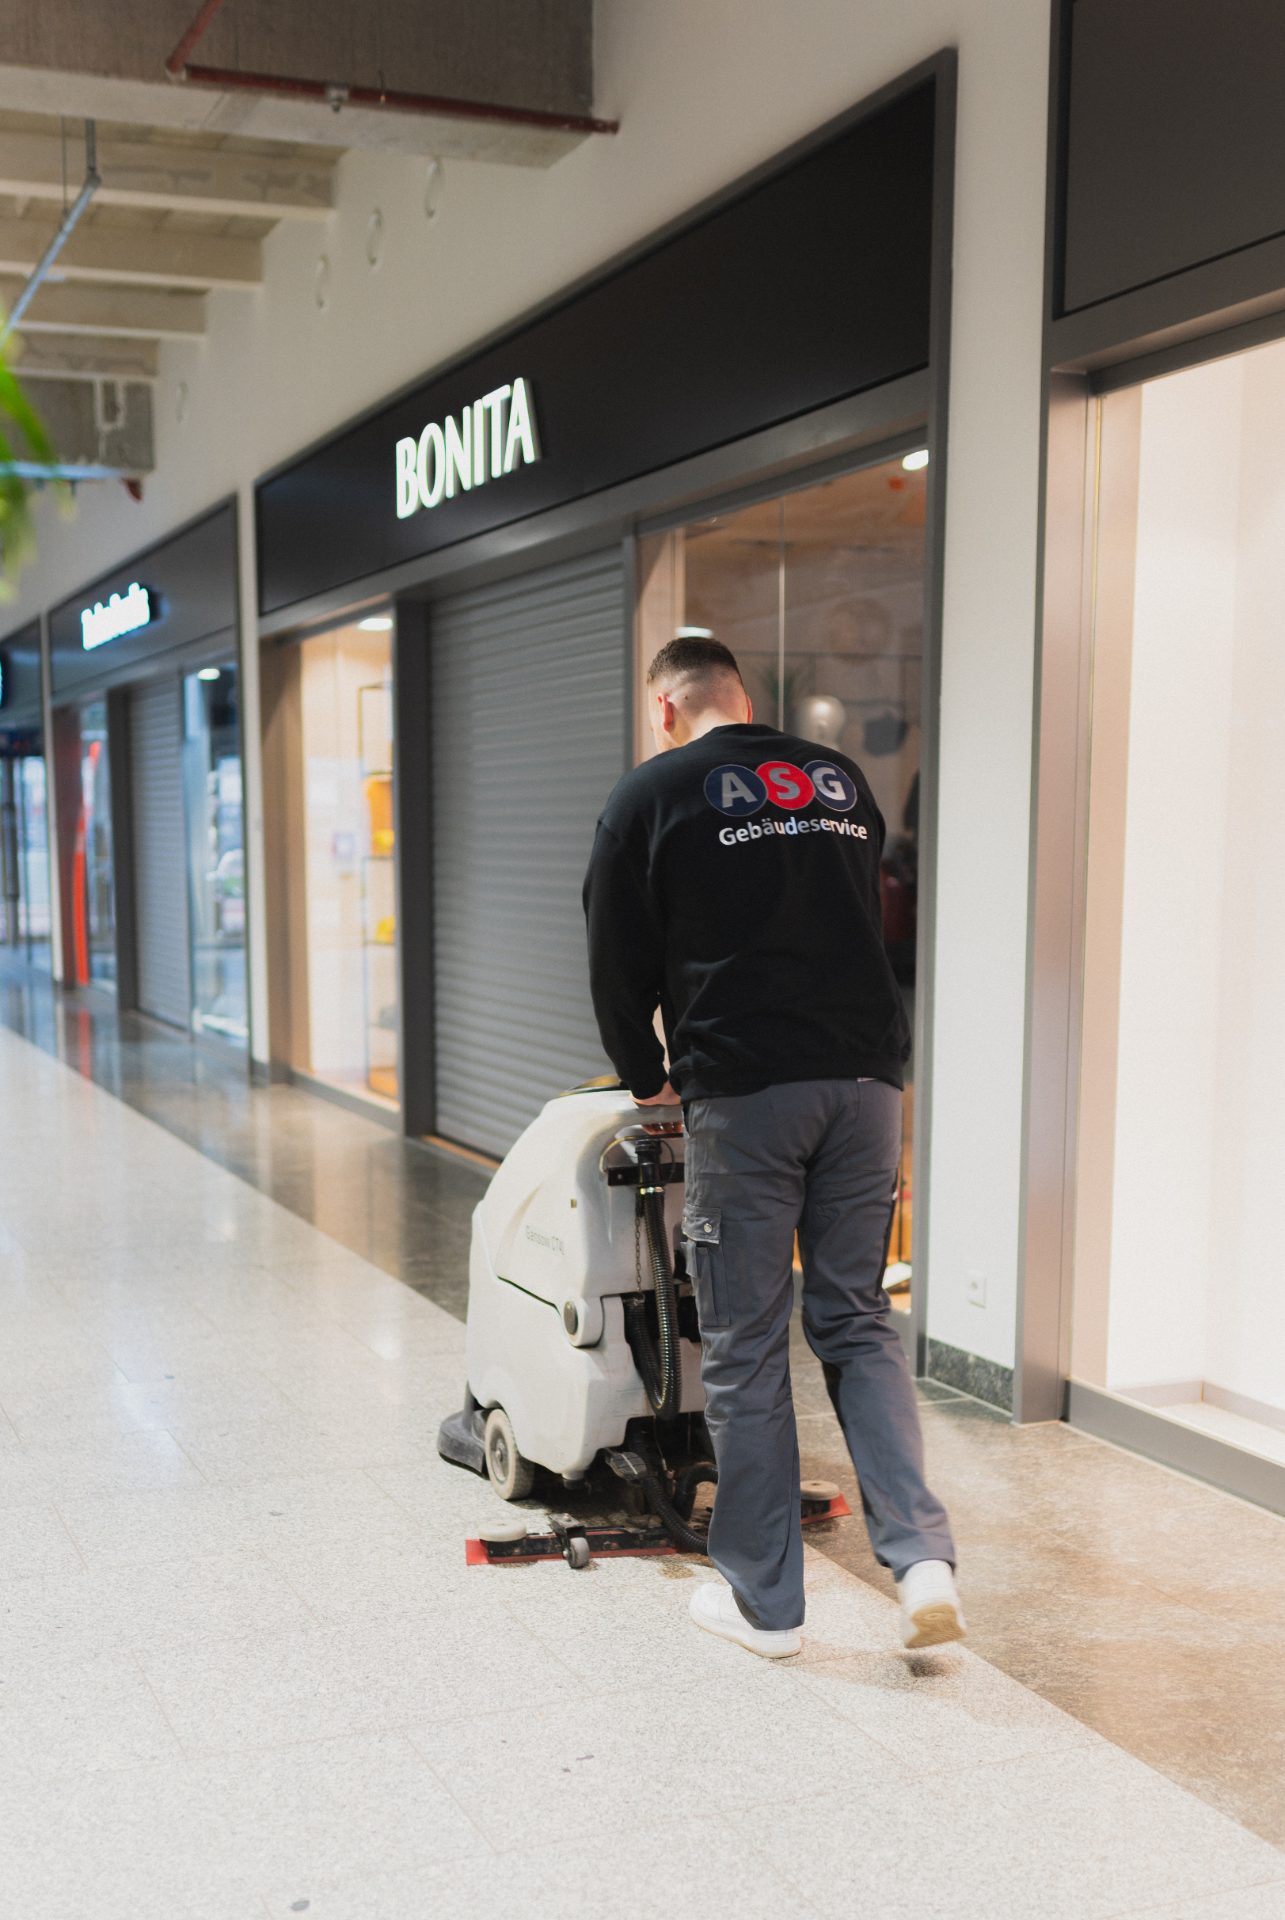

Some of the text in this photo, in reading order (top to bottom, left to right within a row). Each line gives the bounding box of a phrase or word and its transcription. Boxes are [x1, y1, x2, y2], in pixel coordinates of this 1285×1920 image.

[395, 376, 537, 520] BONITA
[721, 766, 847, 809] ASG
[718, 816, 868, 846] Gebäudeservice
